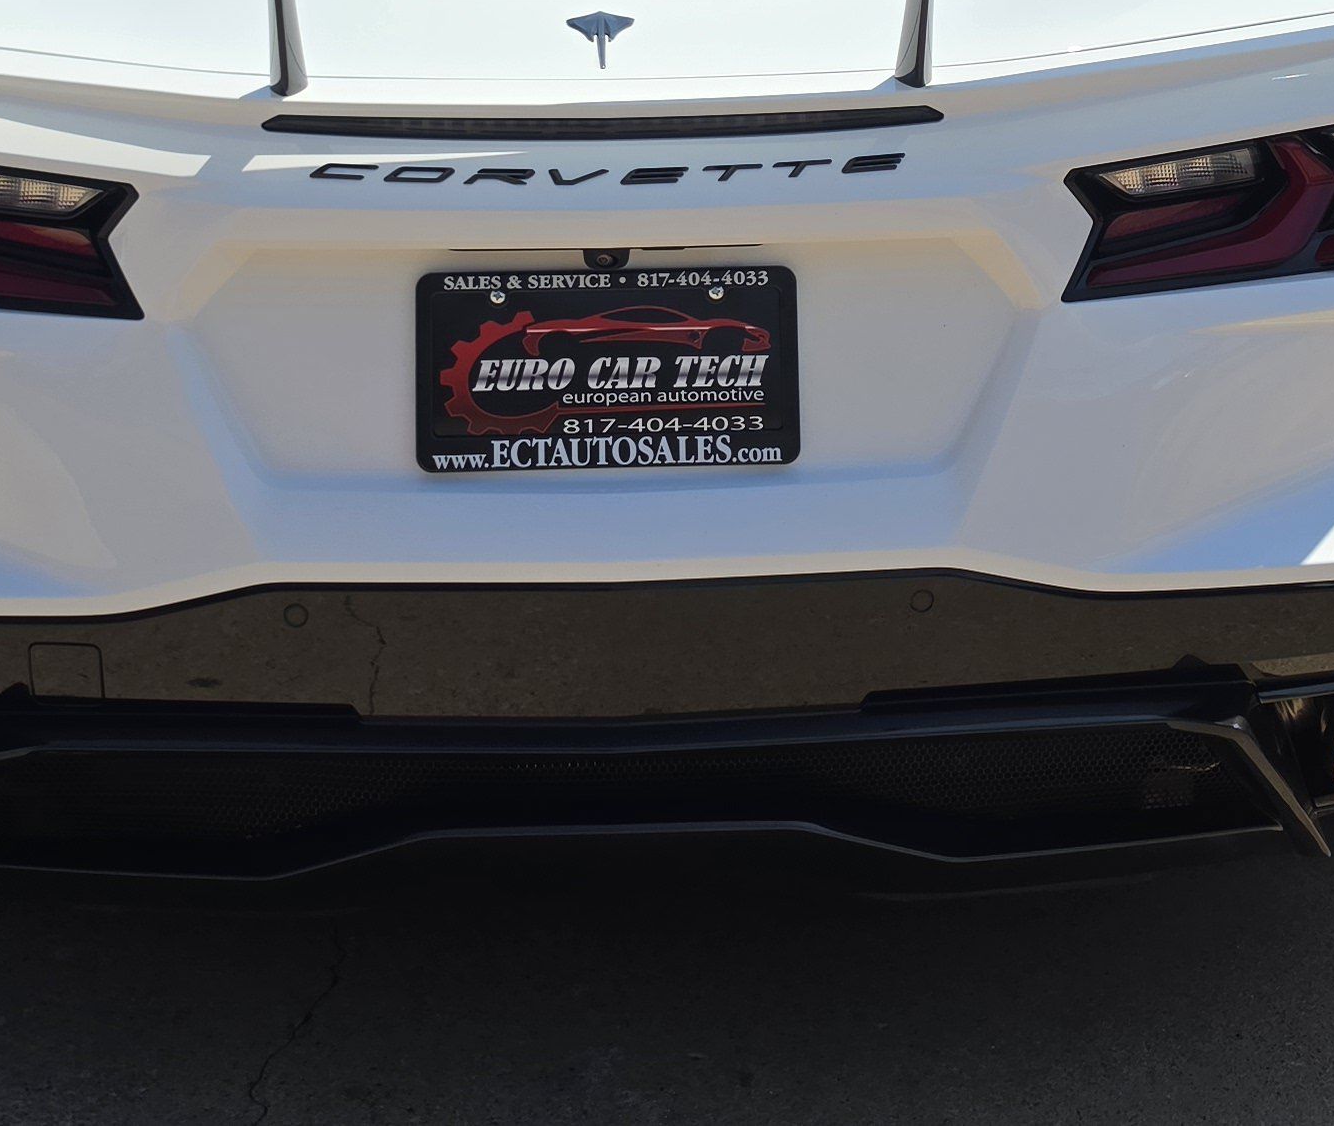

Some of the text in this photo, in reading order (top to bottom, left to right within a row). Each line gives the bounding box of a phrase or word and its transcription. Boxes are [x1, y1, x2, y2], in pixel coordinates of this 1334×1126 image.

[310, 152, 905, 186] CORVETTE
[443, 270, 769, 291] SALES & SERVICE 817-404-4033
[472, 354, 770, 392] EURO CAR TECH
[562, 387, 765, 407] european automotive
[562, 415, 764, 434] 817-404-4033
[431, 434, 783, 469] www.ECTAUTOSALES.com
